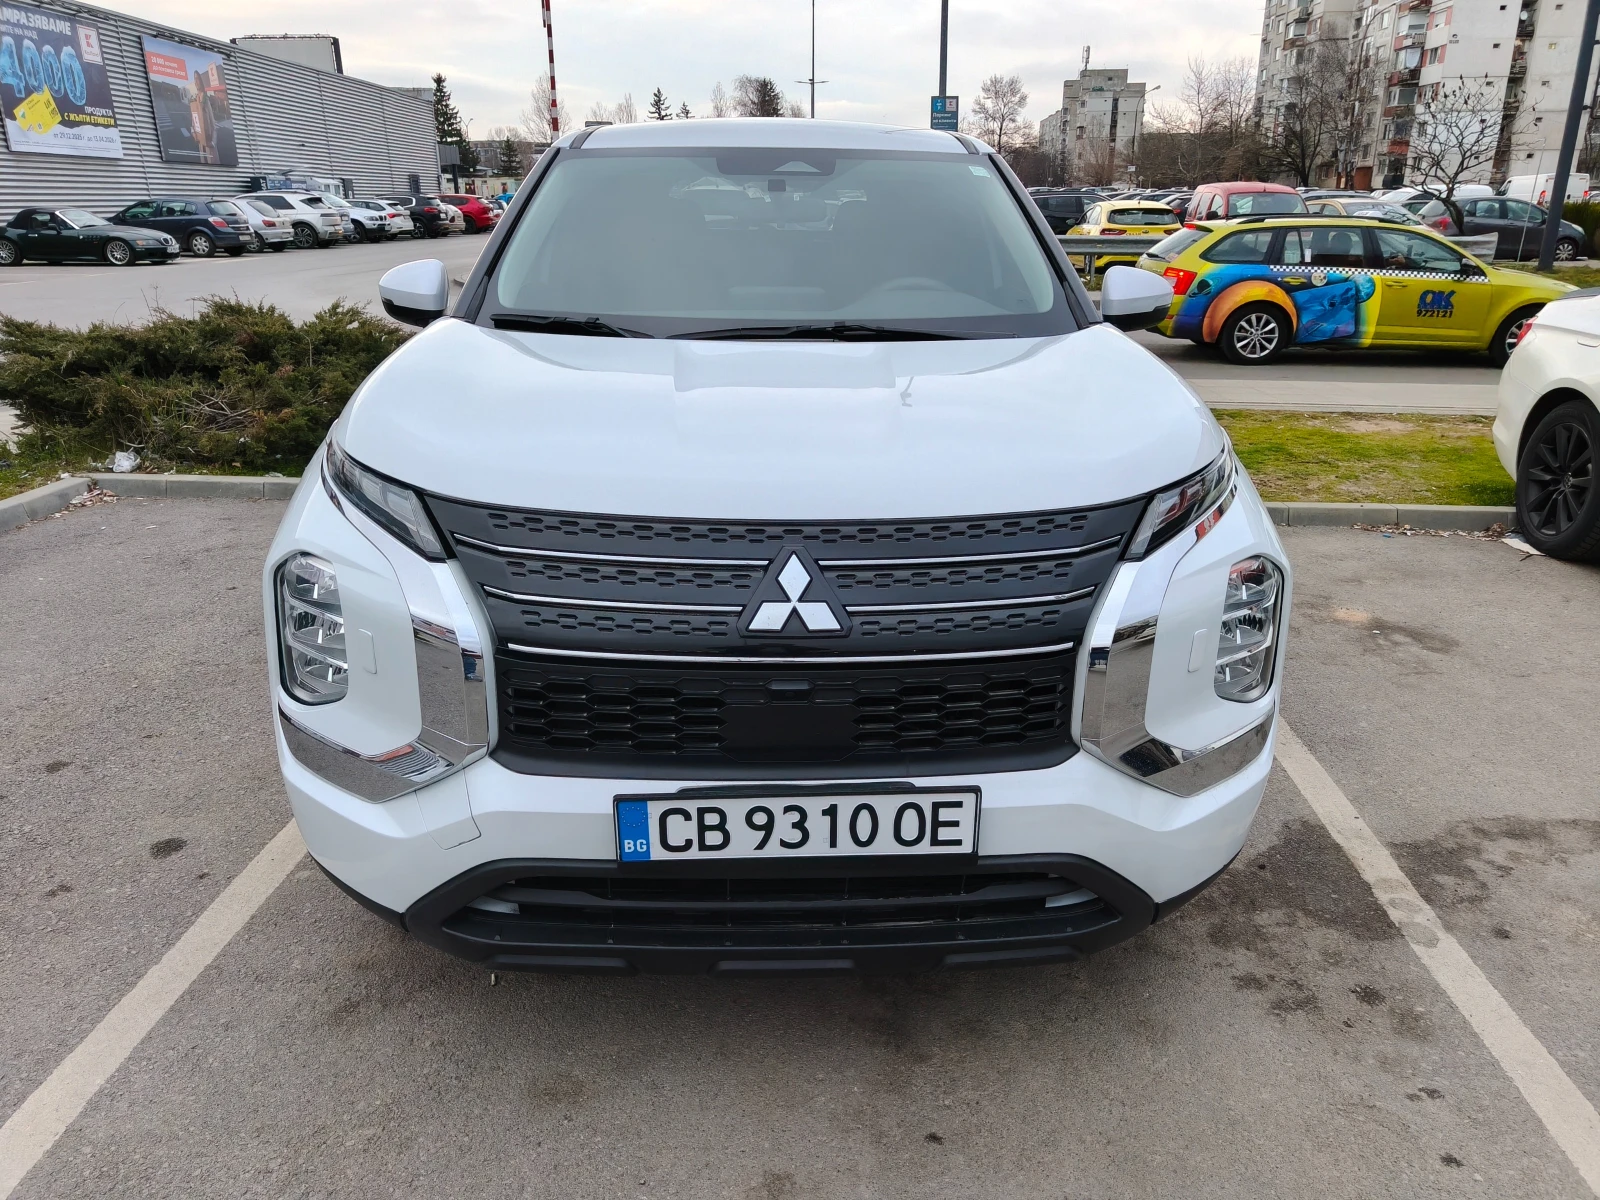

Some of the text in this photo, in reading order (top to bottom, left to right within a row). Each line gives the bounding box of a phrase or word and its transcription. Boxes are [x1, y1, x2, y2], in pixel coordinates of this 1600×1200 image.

[0, 35, 86, 106] 4000
[84, 106, 113, 117] ПРОДУКТА
[64, 112, 115, 126] С ЖЪЛТИ ЕТИКЕТИ
[1416, 309, 1453, 318] 972121
[658, 801, 964, 853] CB 9310 OE
[624, 839, 647, 852] BG
